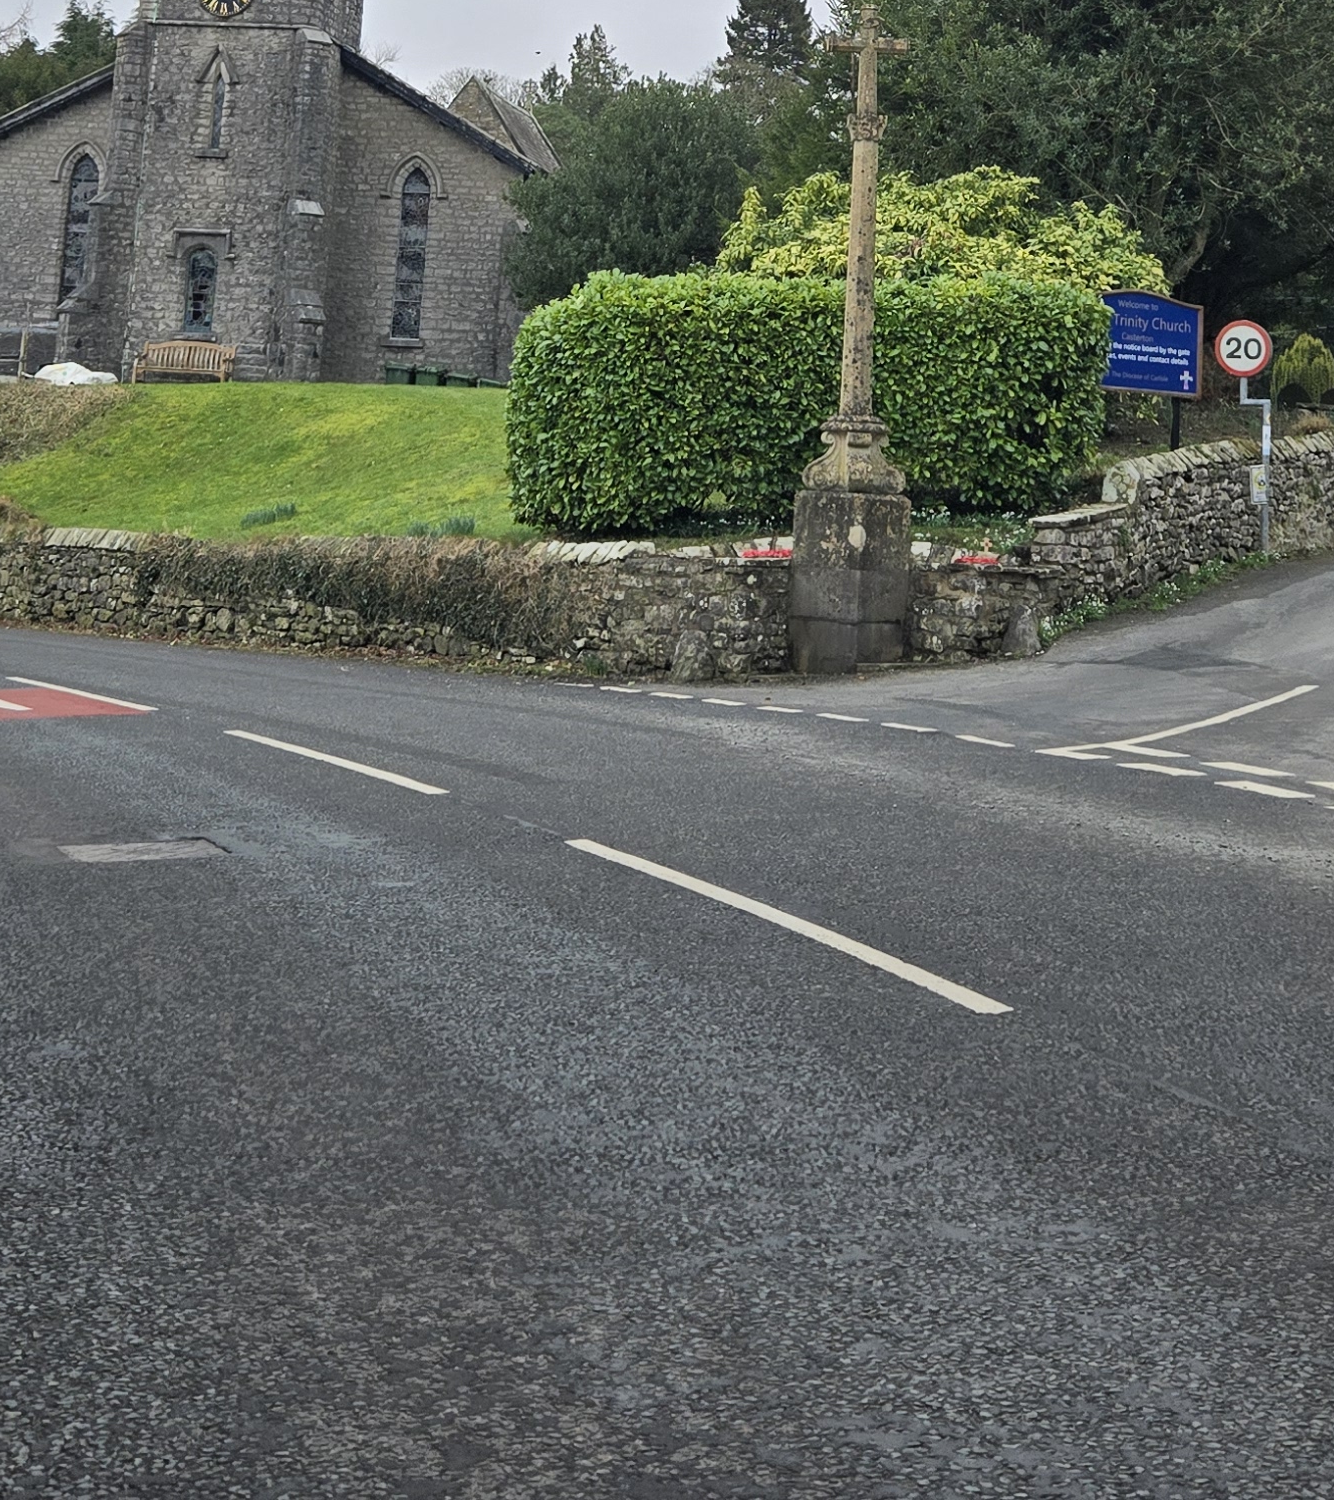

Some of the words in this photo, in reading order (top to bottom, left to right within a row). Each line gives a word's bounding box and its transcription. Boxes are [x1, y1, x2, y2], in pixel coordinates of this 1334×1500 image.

[1118, 299, 1149, 310] Welcome
[1151, 303, 1159, 311] to
[1114, 313, 1149, 332] Trinity
[1152, 317, 1192, 333] Church
[1123, 343, 1141, 351] notice
[1226, 337, 1262, 360] 20
